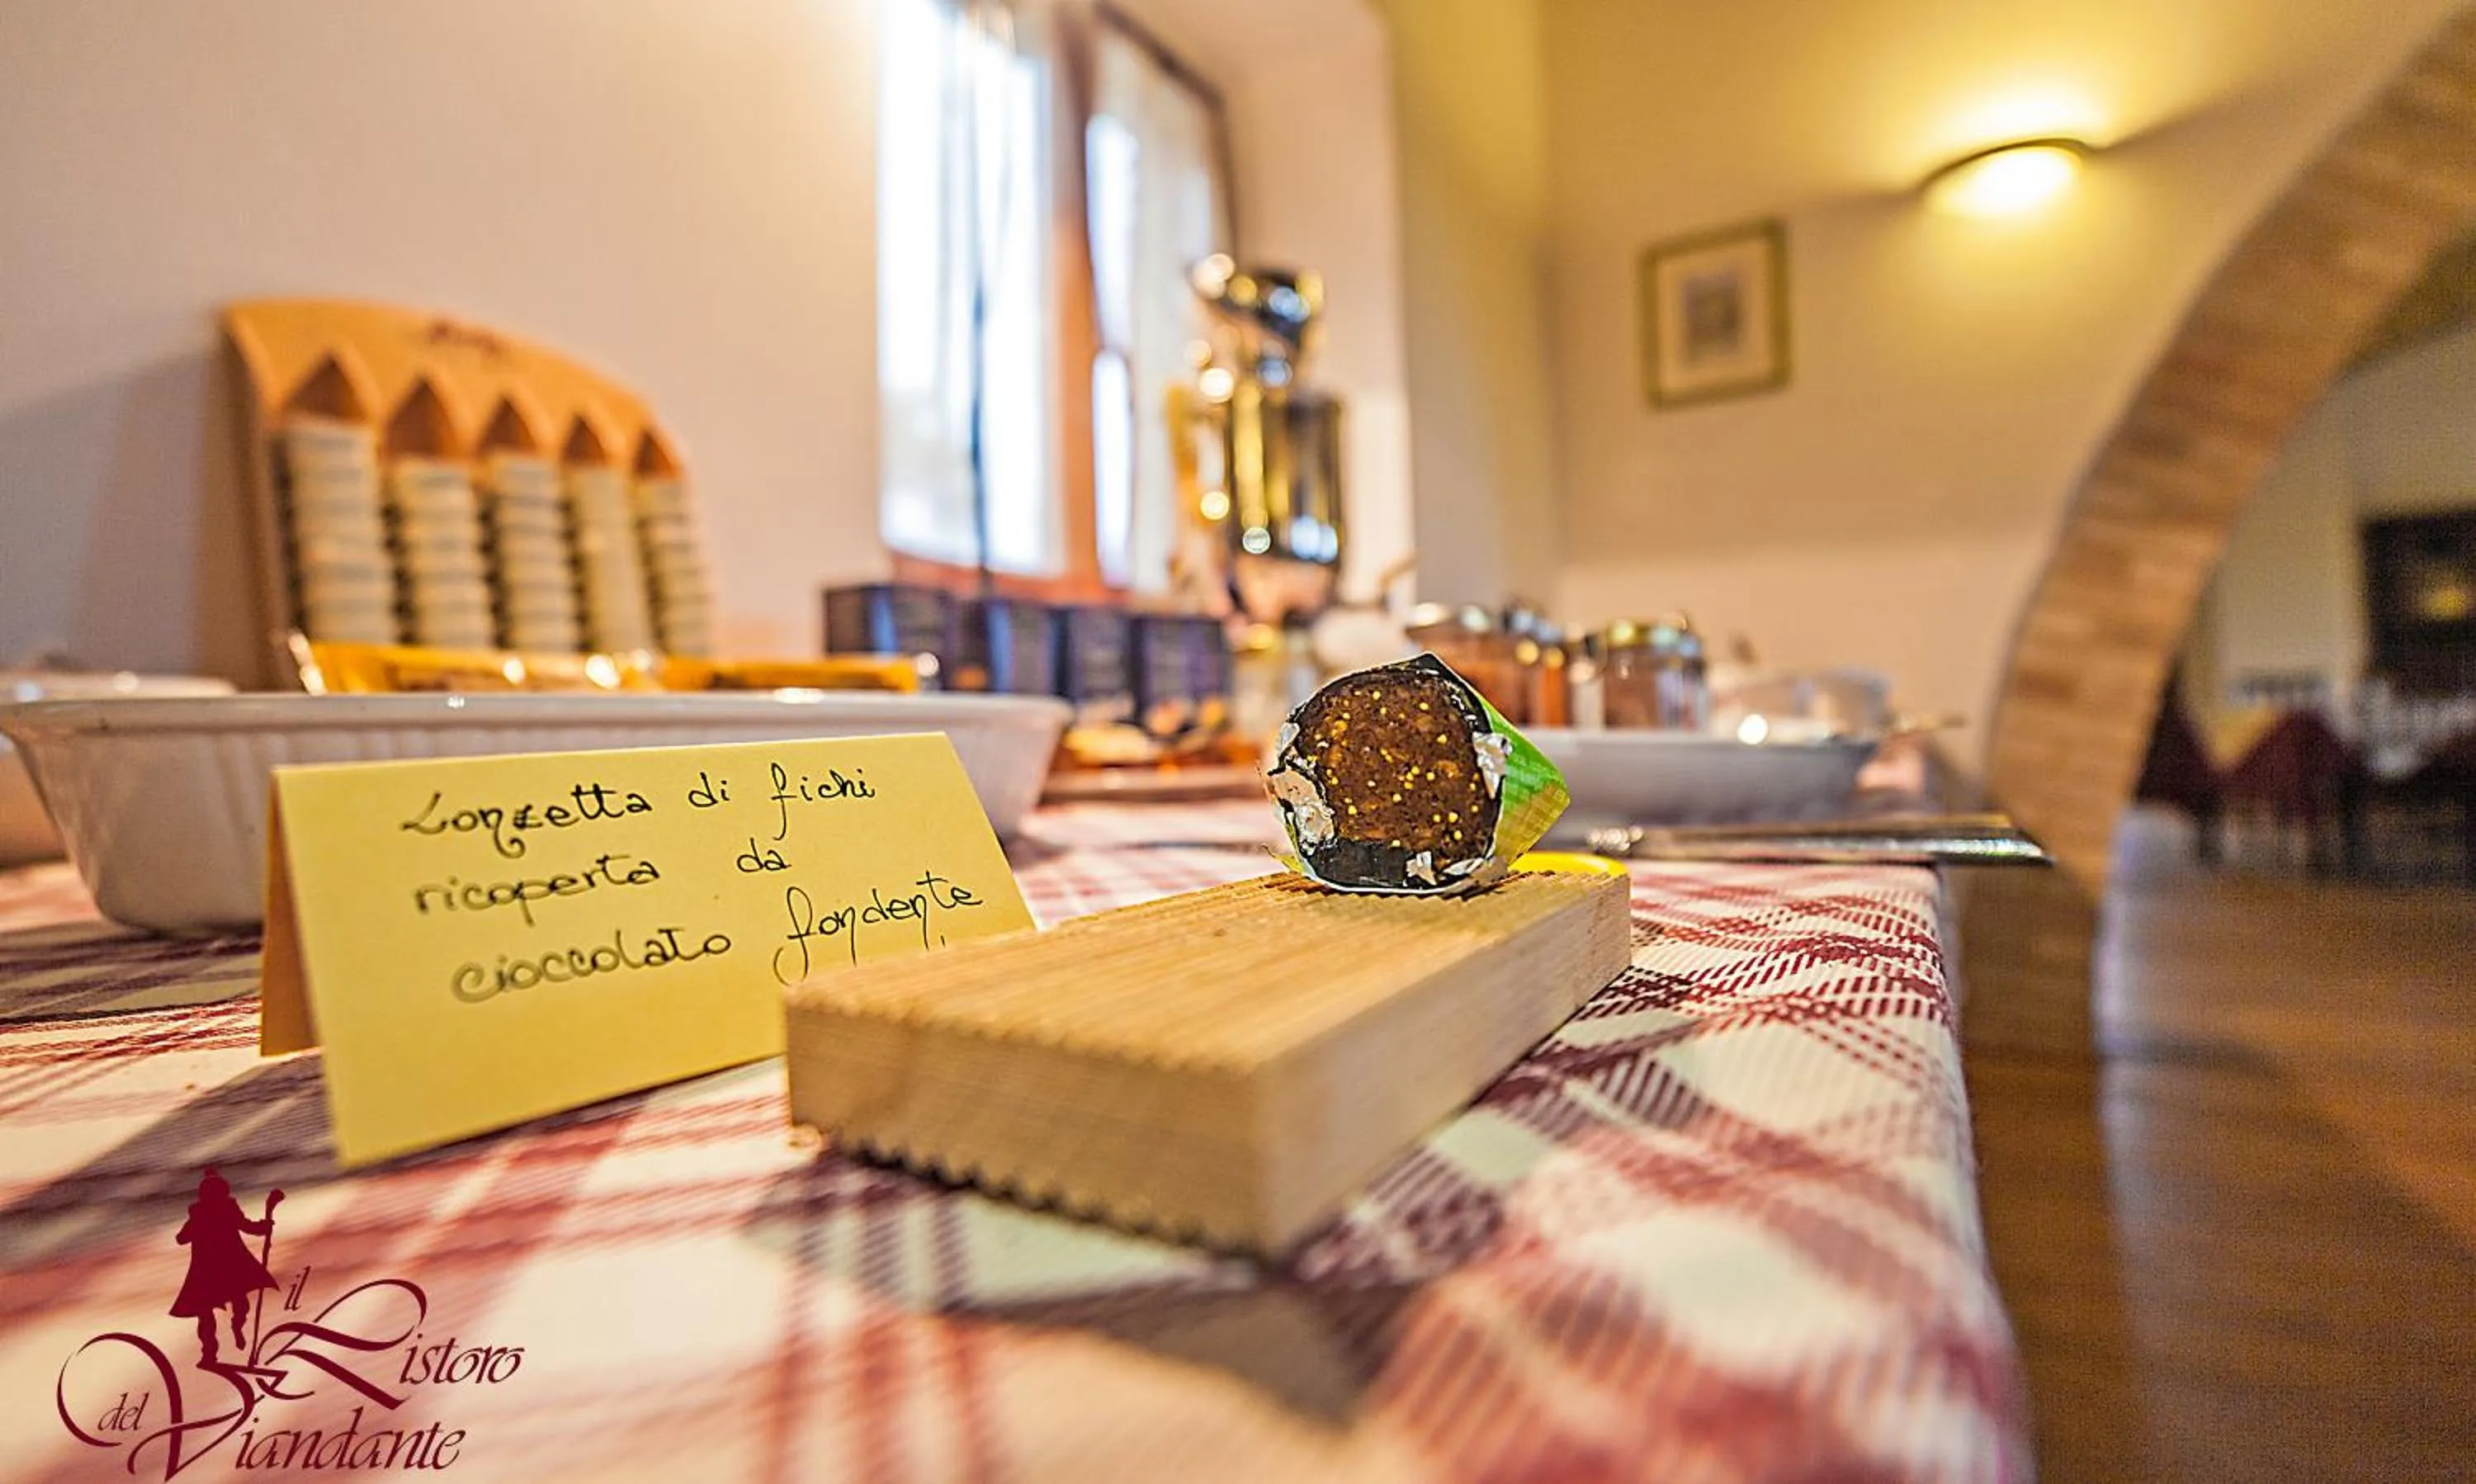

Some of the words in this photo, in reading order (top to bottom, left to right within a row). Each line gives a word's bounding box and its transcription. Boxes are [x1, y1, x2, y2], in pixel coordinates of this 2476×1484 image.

[688, 771, 732, 809] di
[770, 762, 877, 842] fichi
[413, 853, 660, 926] ricoperta
[736, 839, 791, 877] da
[451, 927, 732, 1004] cioccolato
[773, 870, 985, 987] fondente
